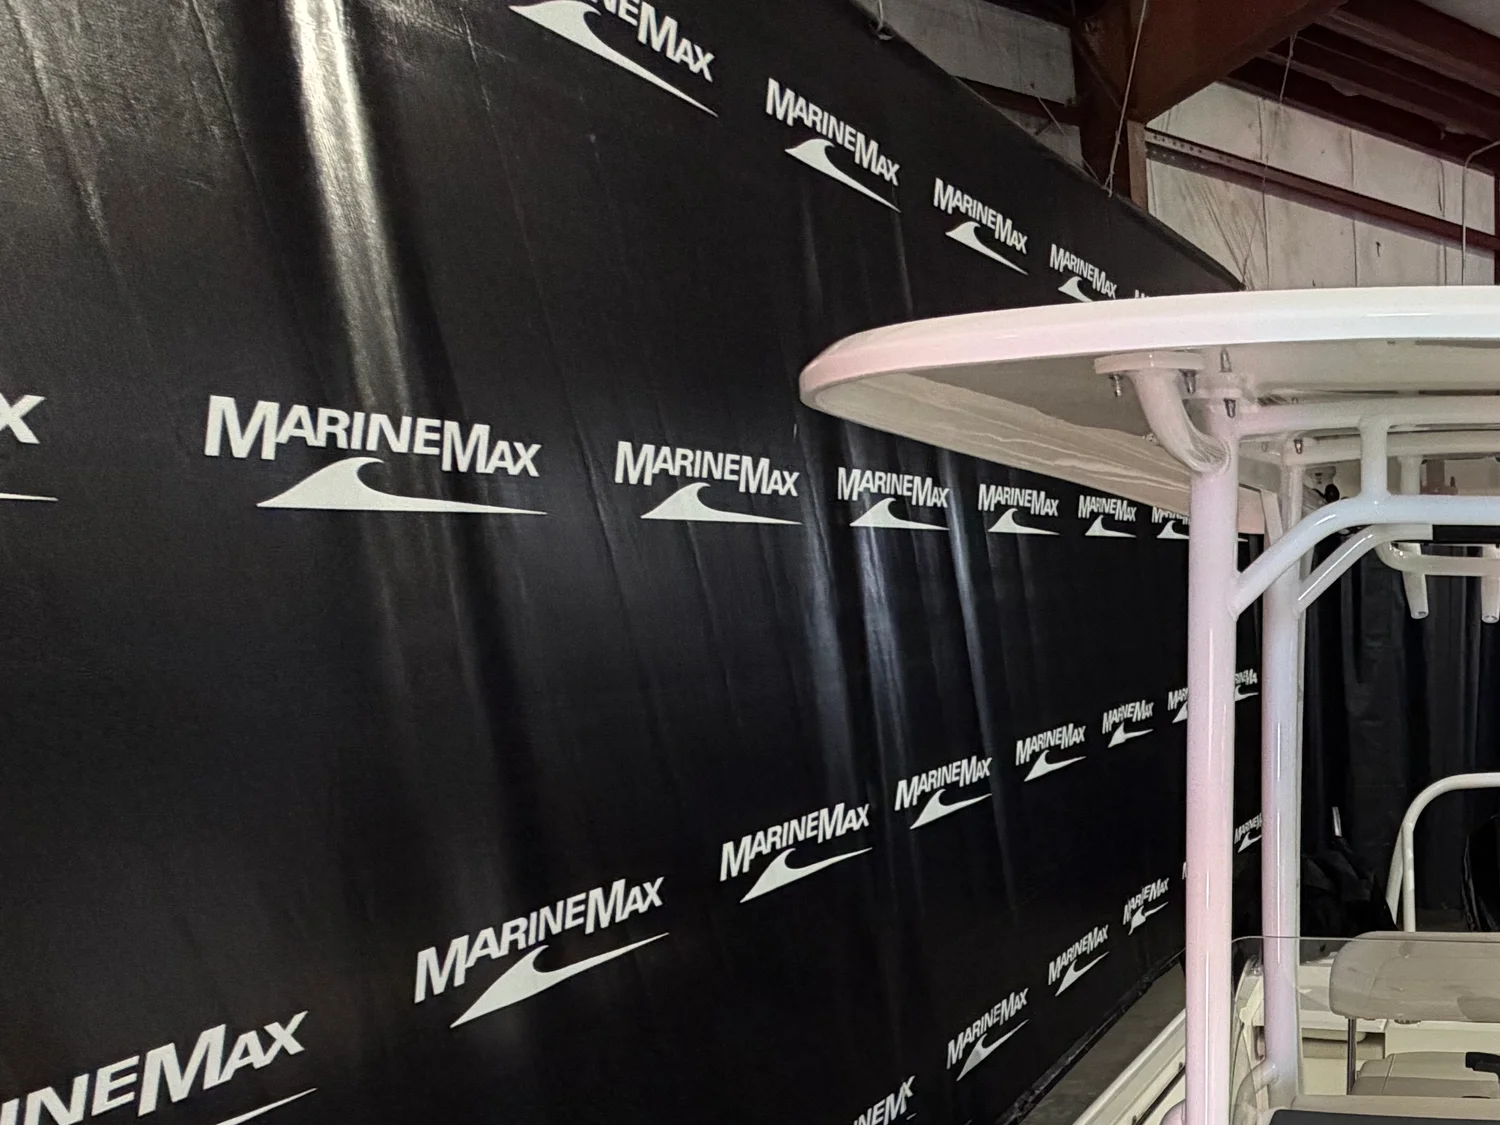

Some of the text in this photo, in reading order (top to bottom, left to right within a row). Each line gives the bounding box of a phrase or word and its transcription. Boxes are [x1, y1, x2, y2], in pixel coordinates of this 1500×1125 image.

[765, 77, 900, 186] MARINEMAX
[933, 178, 1028, 254] MARINEMAX
[1049, 243, 1118, 300] MARINEMAX
[204, 394, 542, 478] MARINEMAX
[614, 440, 801, 497] MARINEMAX
[837, 466, 950, 509] MARINEMAX
[977, 483, 1060, 517] MARINEMAX
[1077, 494, 1138, 522] MARINEMAX
[1015, 723, 1087, 766] MARINEMAX
[894, 755, 993, 811] MARINEMAX
[719, 803, 871, 882] MARINEMAX
[414, 876, 665, 1004] MARINEMAX
[1047, 924, 1109, 986] MARINEMAX
[946, 987, 1029, 1070] MARINEMAX
